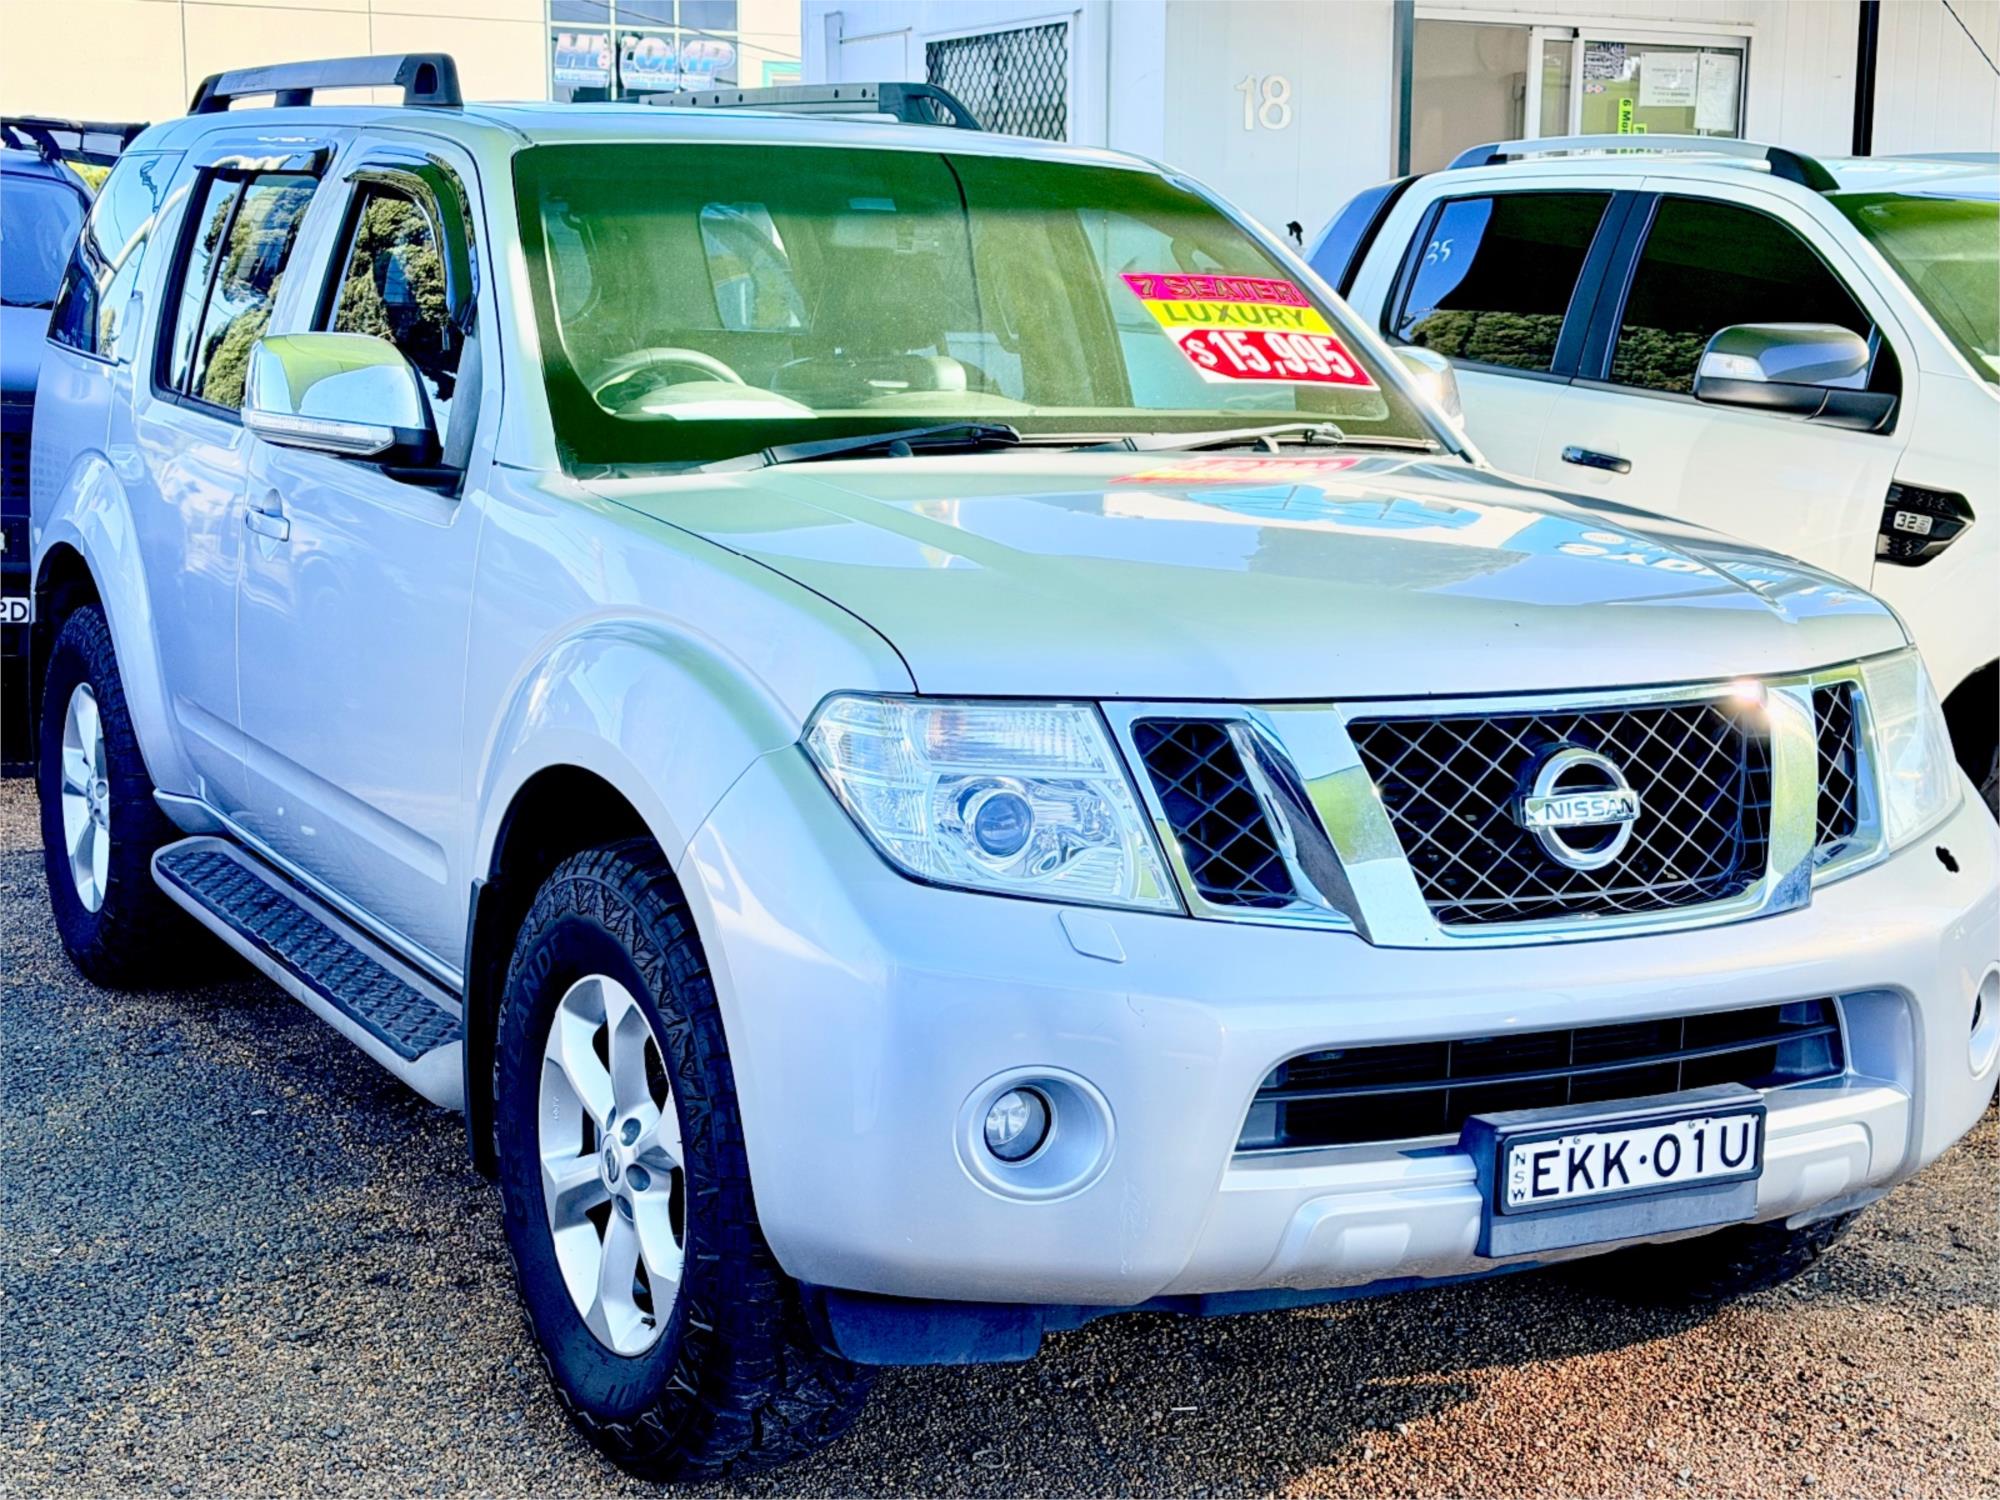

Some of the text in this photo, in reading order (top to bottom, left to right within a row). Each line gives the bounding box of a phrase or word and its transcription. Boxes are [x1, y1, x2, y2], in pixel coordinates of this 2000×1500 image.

[1234, 75, 1292, 129] 18
[1427, 239, 1454, 265] 35
[1131, 279, 1300, 302] 7 SEATER
[1163, 302, 1304, 327] LUXURY
[1185, 331, 1355, 378] $15,995
[1545, 797, 1635, 820] NISSAN
